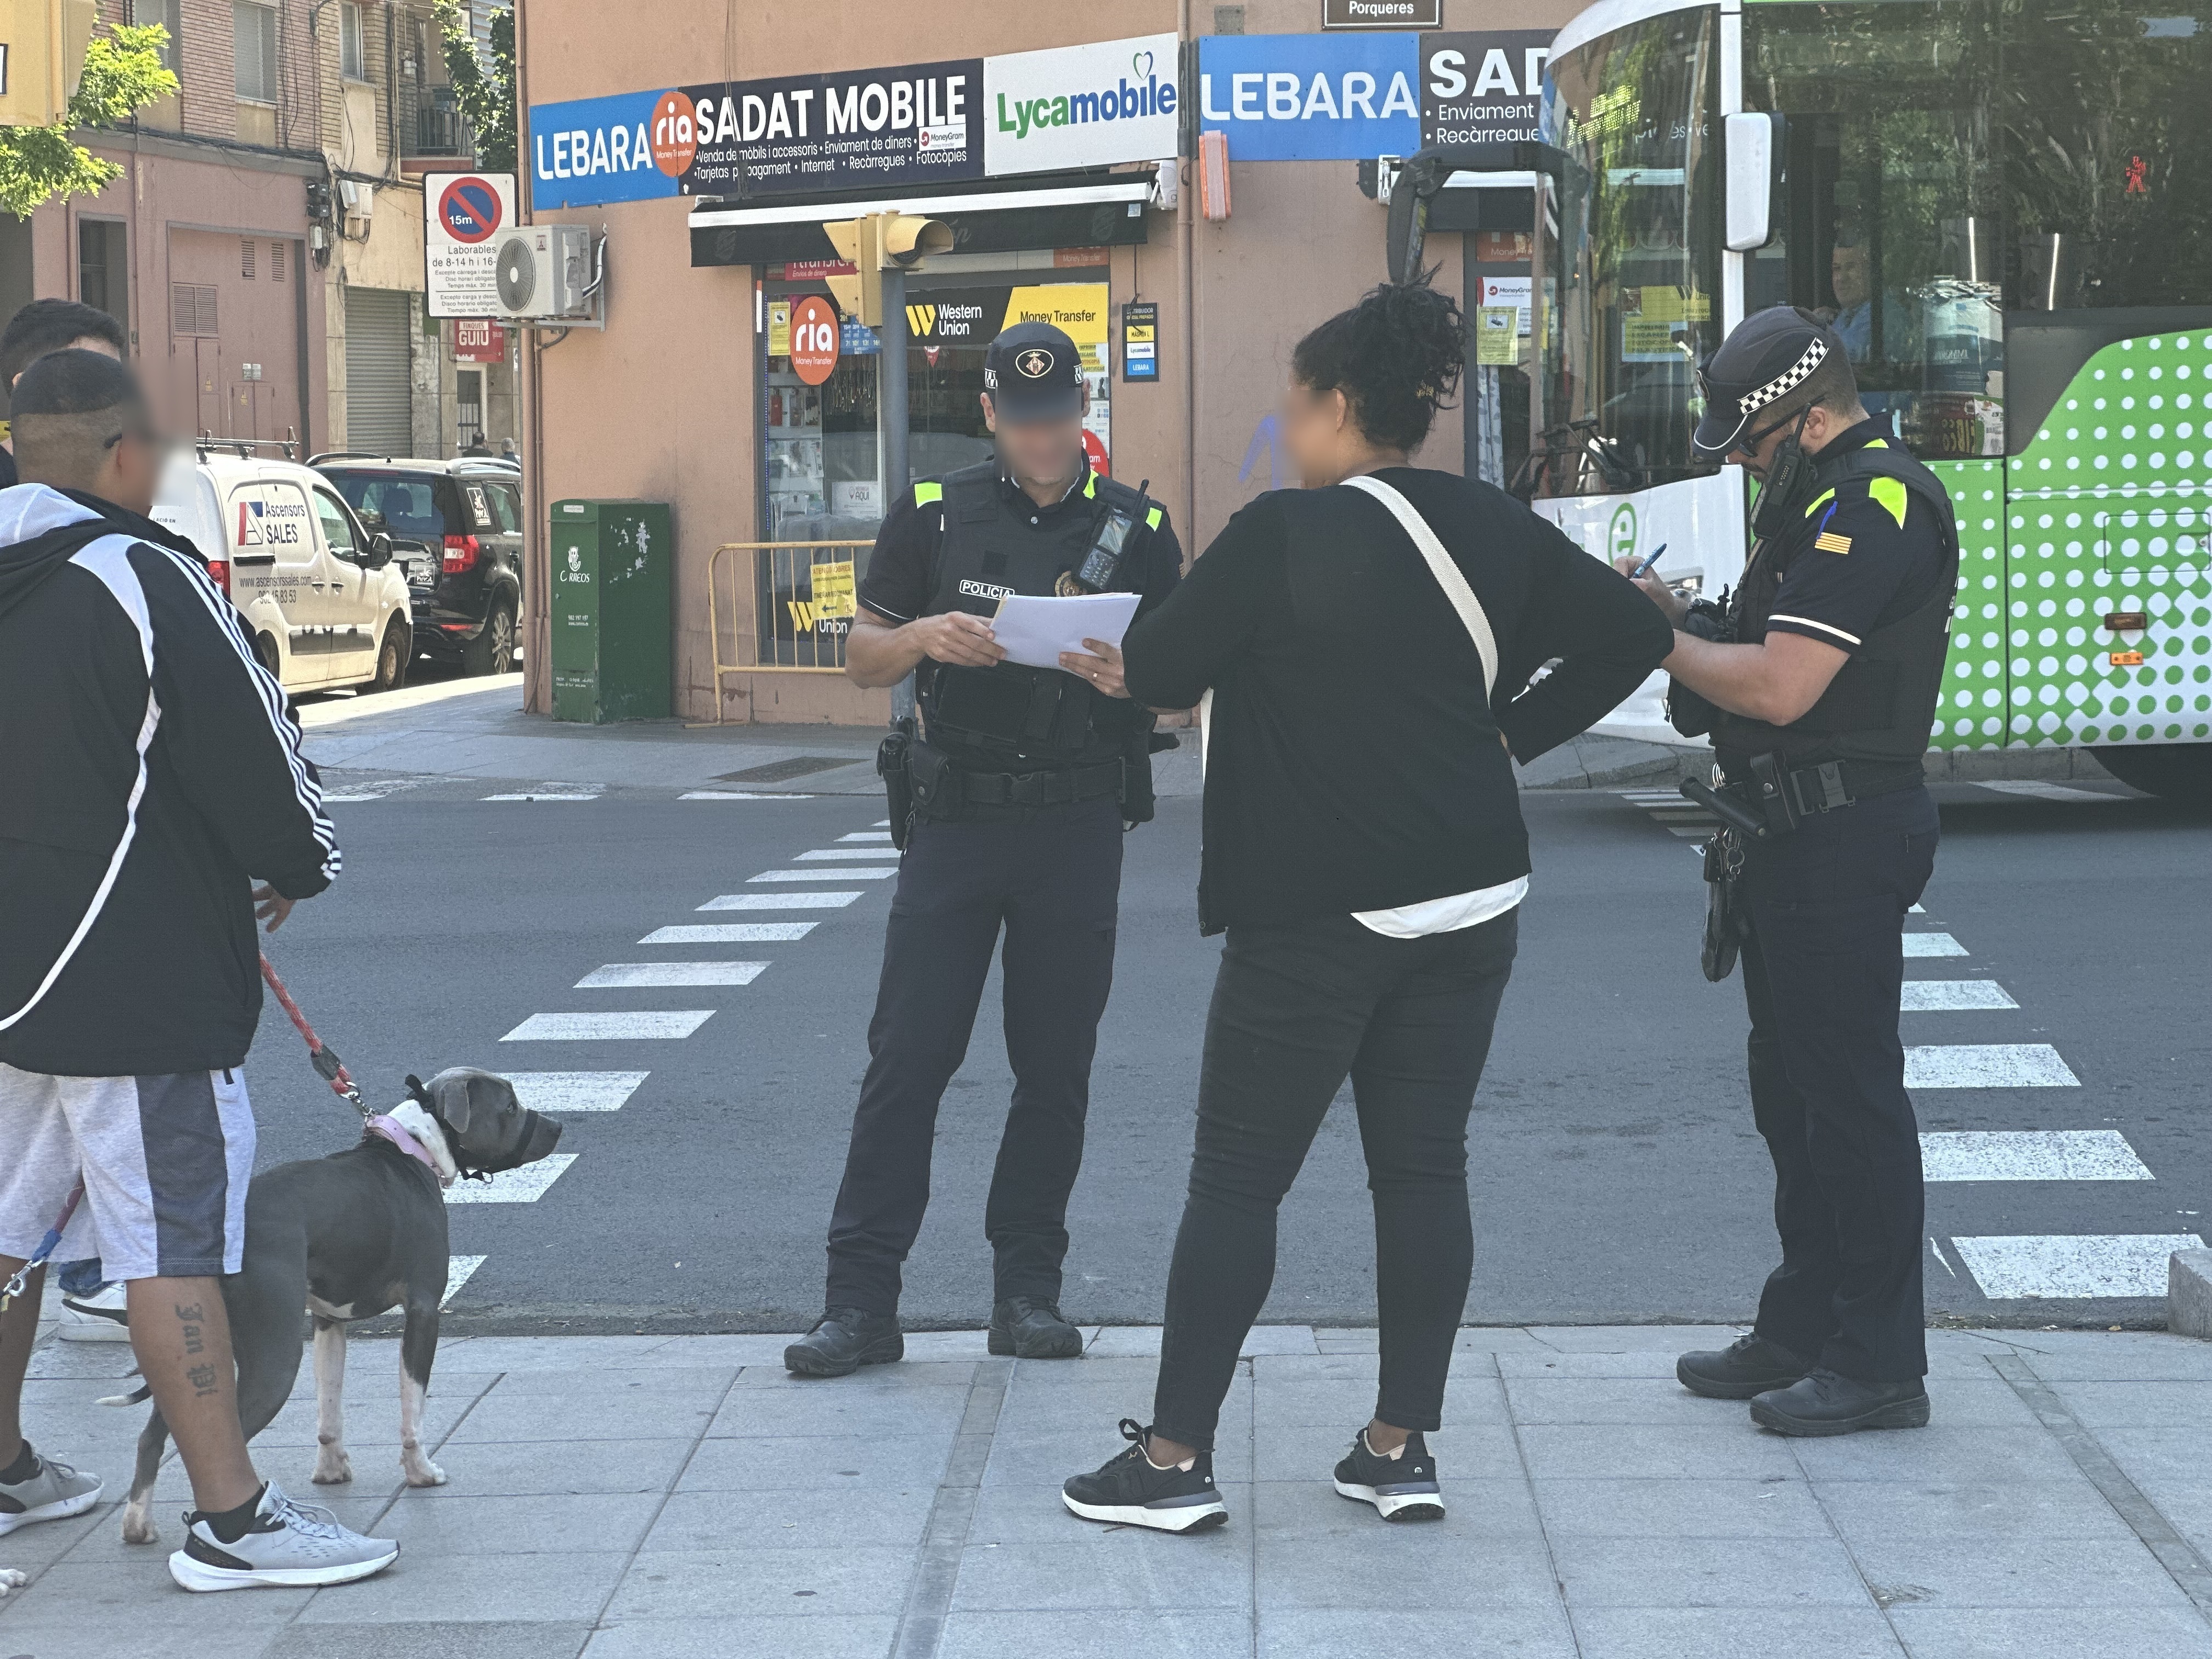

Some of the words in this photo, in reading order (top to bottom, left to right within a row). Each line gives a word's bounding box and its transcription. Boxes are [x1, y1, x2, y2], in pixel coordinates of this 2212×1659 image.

[1349, 1, 1414, 17] Porqueres
[1200, 71, 1419, 120] LEBARA
[696, 89, 814, 145] SADAT
[826, 75, 966, 135] MOBILE
[997, 74, 1177, 139] Lycamobile
[1438, 103, 1534, 121] Enviament
[656, 101, 692, 146] ria
[930, 132, 964, 142] MoneyGram
[537, 122, 653, 180] LEBARA
[698, 149, 724, 163] Venda
[726, 148, 737, 161] de
[740, 145, 766, 160] mòbils
[768, 145, 771, 158] i
[772, 140, 817, 158] accessoris
[825, 138, 870, 154] Enviament
[871, 137, 883, 150] de
[884, 135, 911, 150] diners
[696, 166, 729, 183] Tarjetas
[801, 158, 835, 173] Internet
[850, 154, 905, 171] Recàrregues
[916, 149, 967, 167] Fotocòpies
[449, 216, 472, 225] 15m
[448, 245, 496, 254] Laborables
[432, 257, 443, 267] de
[446, 257, 466, 267] 8-14
[469, 257, 474, 266] h
[477, 257, 479, 266] i
[938, 303, 982, 319] Western
[1020, 311, 1052, 324] Money
[1054, 309, 1096, 323] Transfer
[795, 308, 833, 352] ria
[939, 320, 970, 336] Union
[459, 331, 489, 346] GUIU
[795, 357, 812, 366] Money
[812, 356, 832, 365] Transfer
[266, 501, 305, 517] Ascensors
[266, 523, 298, 544] SALES
[239, 573, 312, 588] www.ascensorssales.com
[280, 589, 288, 604] 83
[289, 589, 297, 603] 53
[962, 582, 1010, 599] POLICIA
